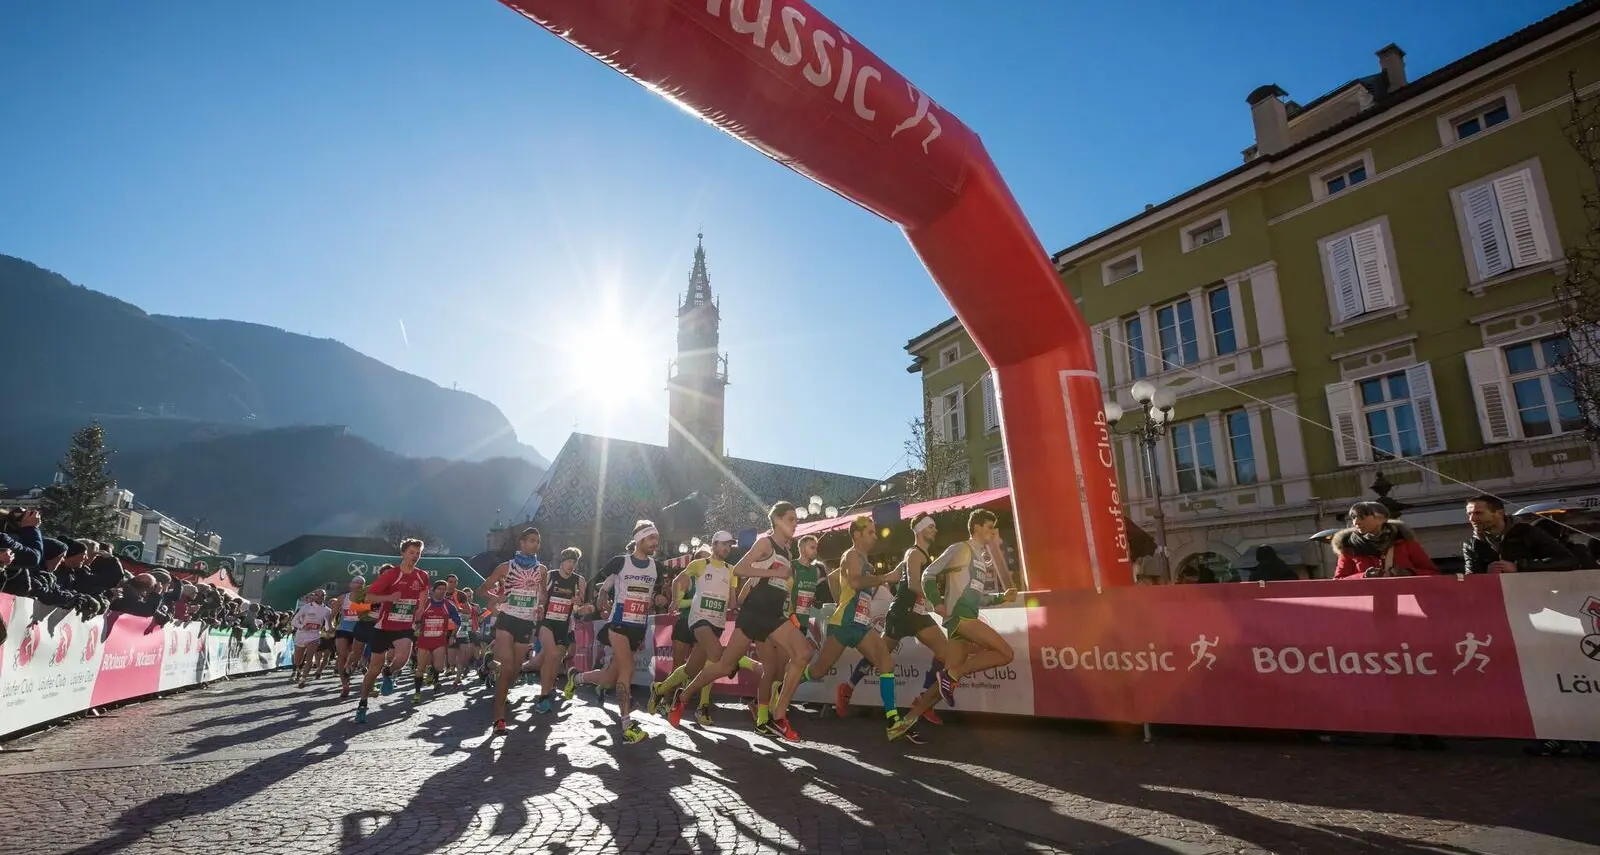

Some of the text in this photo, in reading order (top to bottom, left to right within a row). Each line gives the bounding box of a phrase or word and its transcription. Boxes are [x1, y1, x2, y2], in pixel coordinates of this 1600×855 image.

[706, 0, 882, 121] assic
[1094, 410, 1130, 563] Läufer Club
[552, 604, 565, 613] 581
[630, 602, 645, 613] 574
[705, 599, 723, 610] 1095
[1041, 643, 1177, 672] BOclassic
[1252, 642, 1438, 675] BOclassic
[894, 663, 920, 678] Club
[983, 666, 1017, 681] Club
